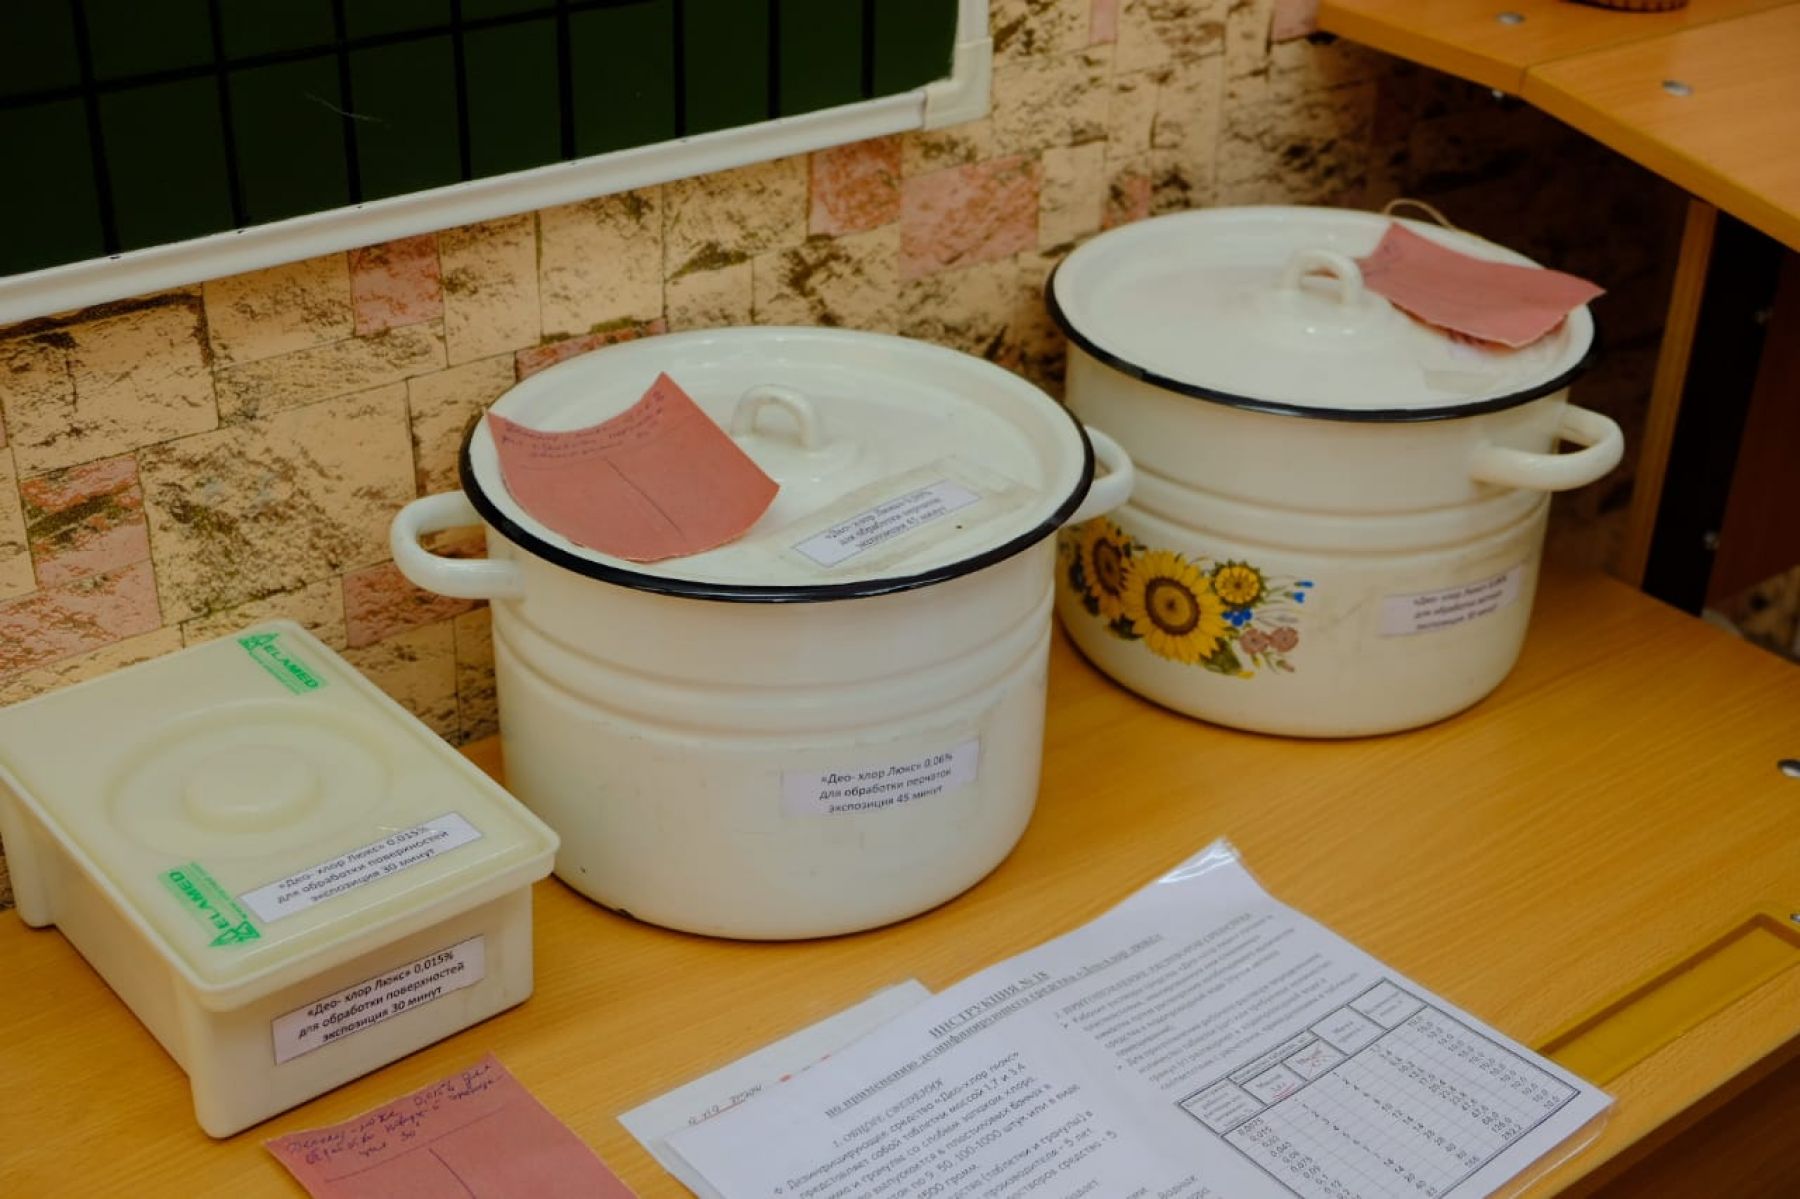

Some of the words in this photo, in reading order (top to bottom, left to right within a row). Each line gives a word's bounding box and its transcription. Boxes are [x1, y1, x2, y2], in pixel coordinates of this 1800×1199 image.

[263, 644, 318, 688] ELAMED
[819, 789, 842, 801] для
[843, 780, 904, 798] обработки
[905, 767, 953, 788] перчаток
[820, 771, 856, 785] «Део-
[858, 769, 886, 781] хлор
[886, 761, 923, 777] Люкс»
[923, 752, 953, 769] 0,06%
[828, 797, 894, 814] экспозиция
[896, 793, 910, 803] 45
[911, 784, 944, 801] минут
[277, 889, 300, 905] для
[302, 862, 367, 893] обработки
[367, 829, 450, 868] поверхностей
[310, 871, 381, 903] экспозиция
[382, 861, 399, 875] 30
[399, 846, 436, 867] минут
[317, 858, 346, 877] хлор
[168, 870, 231, 930] ELAMED
[297, 1022, 320, 1041] для
[321, 996, 384, 1028] обработки
[385, 961, 465, 1001] поверхностей
[306, 998, 342, 1017] «Део-
[344, 984, 372, 1003] хлор
[374, 970, 412, 991] Люкс»
[413, 950, 454, 974] 0,015%
[927, 982, 1020, 1040] ИНСТРУКЦИЯ
[322, 1007, 389, 1043] экспозиция
[390, 999, 406, 1014] 30
[407, 986, 444, 1008] минут
[841, 1059, 918, 1111] применению
